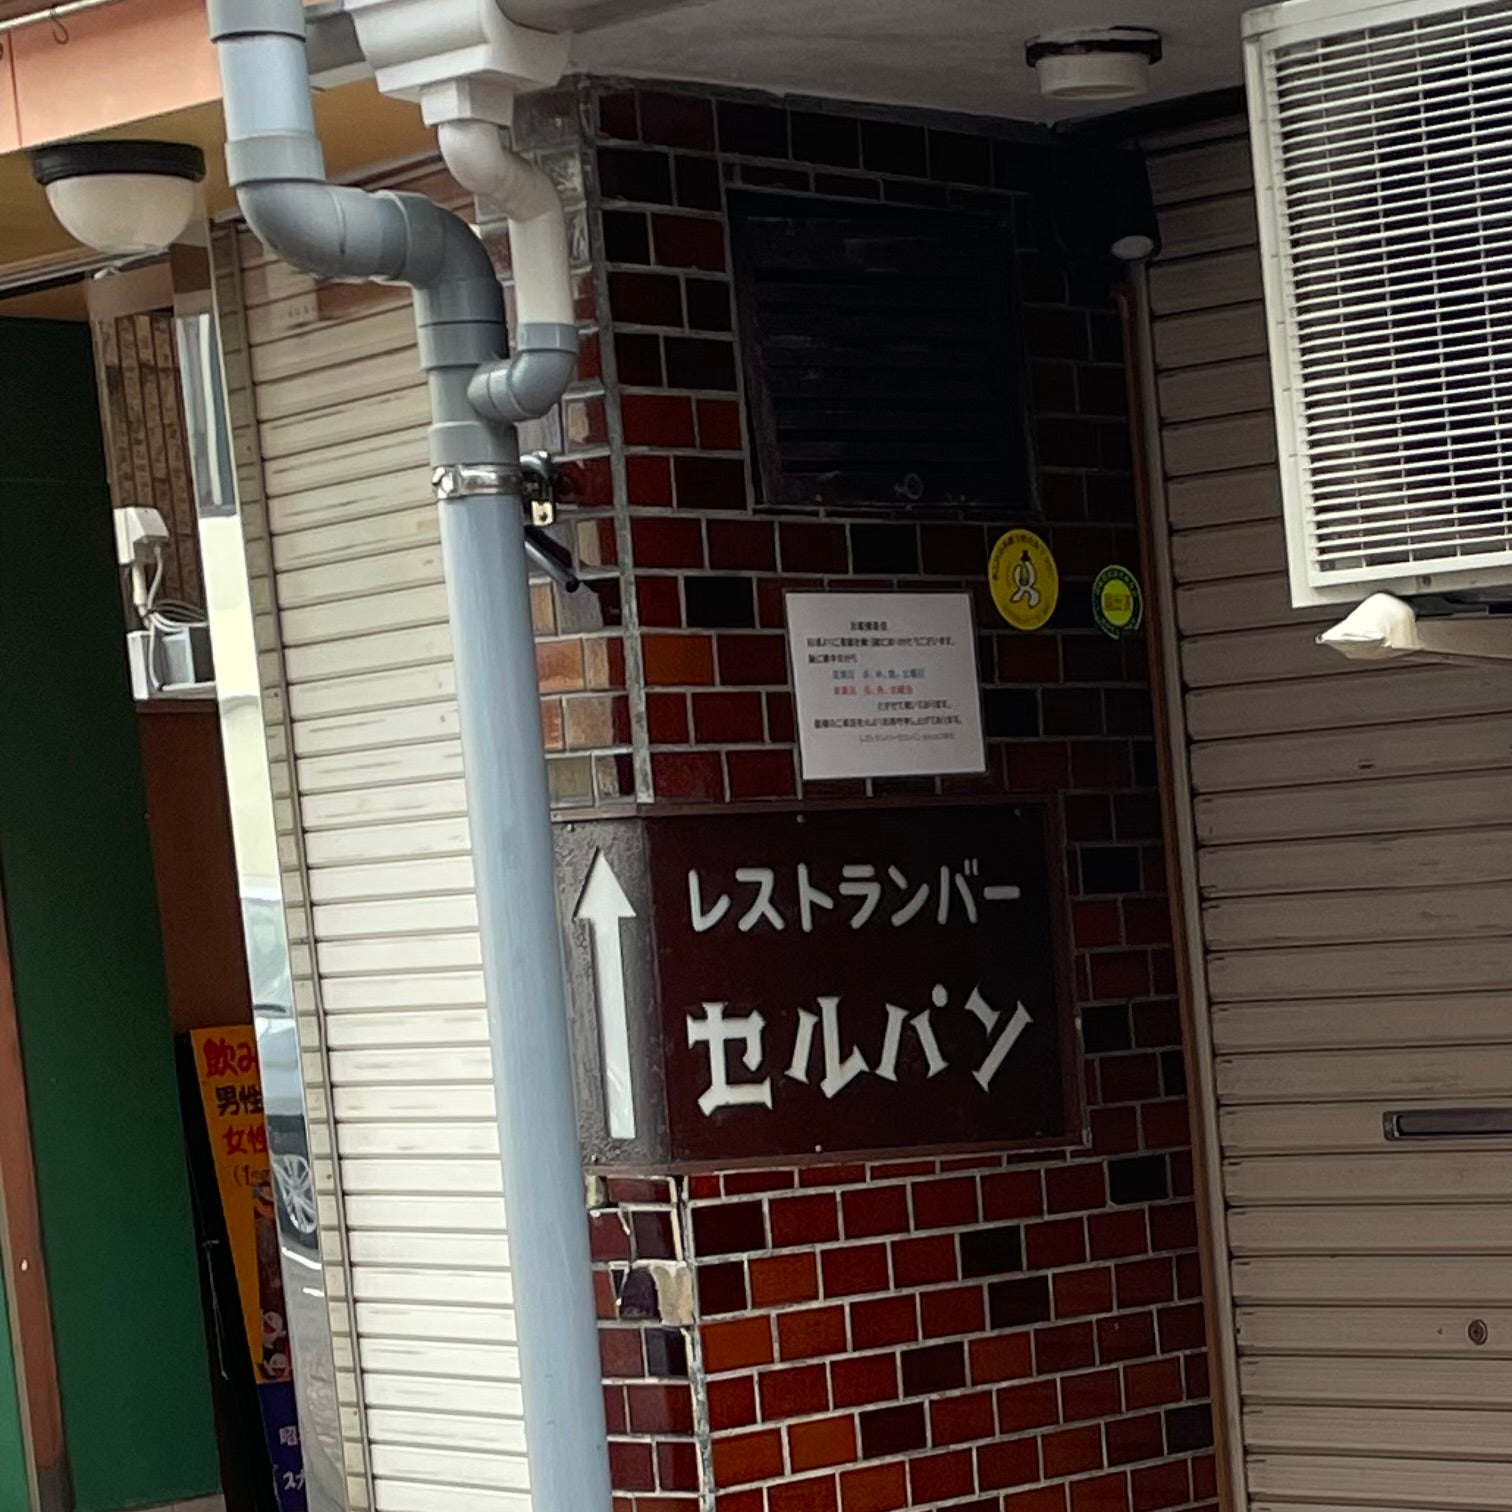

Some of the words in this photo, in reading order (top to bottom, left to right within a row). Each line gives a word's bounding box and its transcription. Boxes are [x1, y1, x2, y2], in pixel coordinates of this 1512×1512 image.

[688, 857, 1021, 933] レストランバー
[686, 983, 1034, 1118] セルパン
